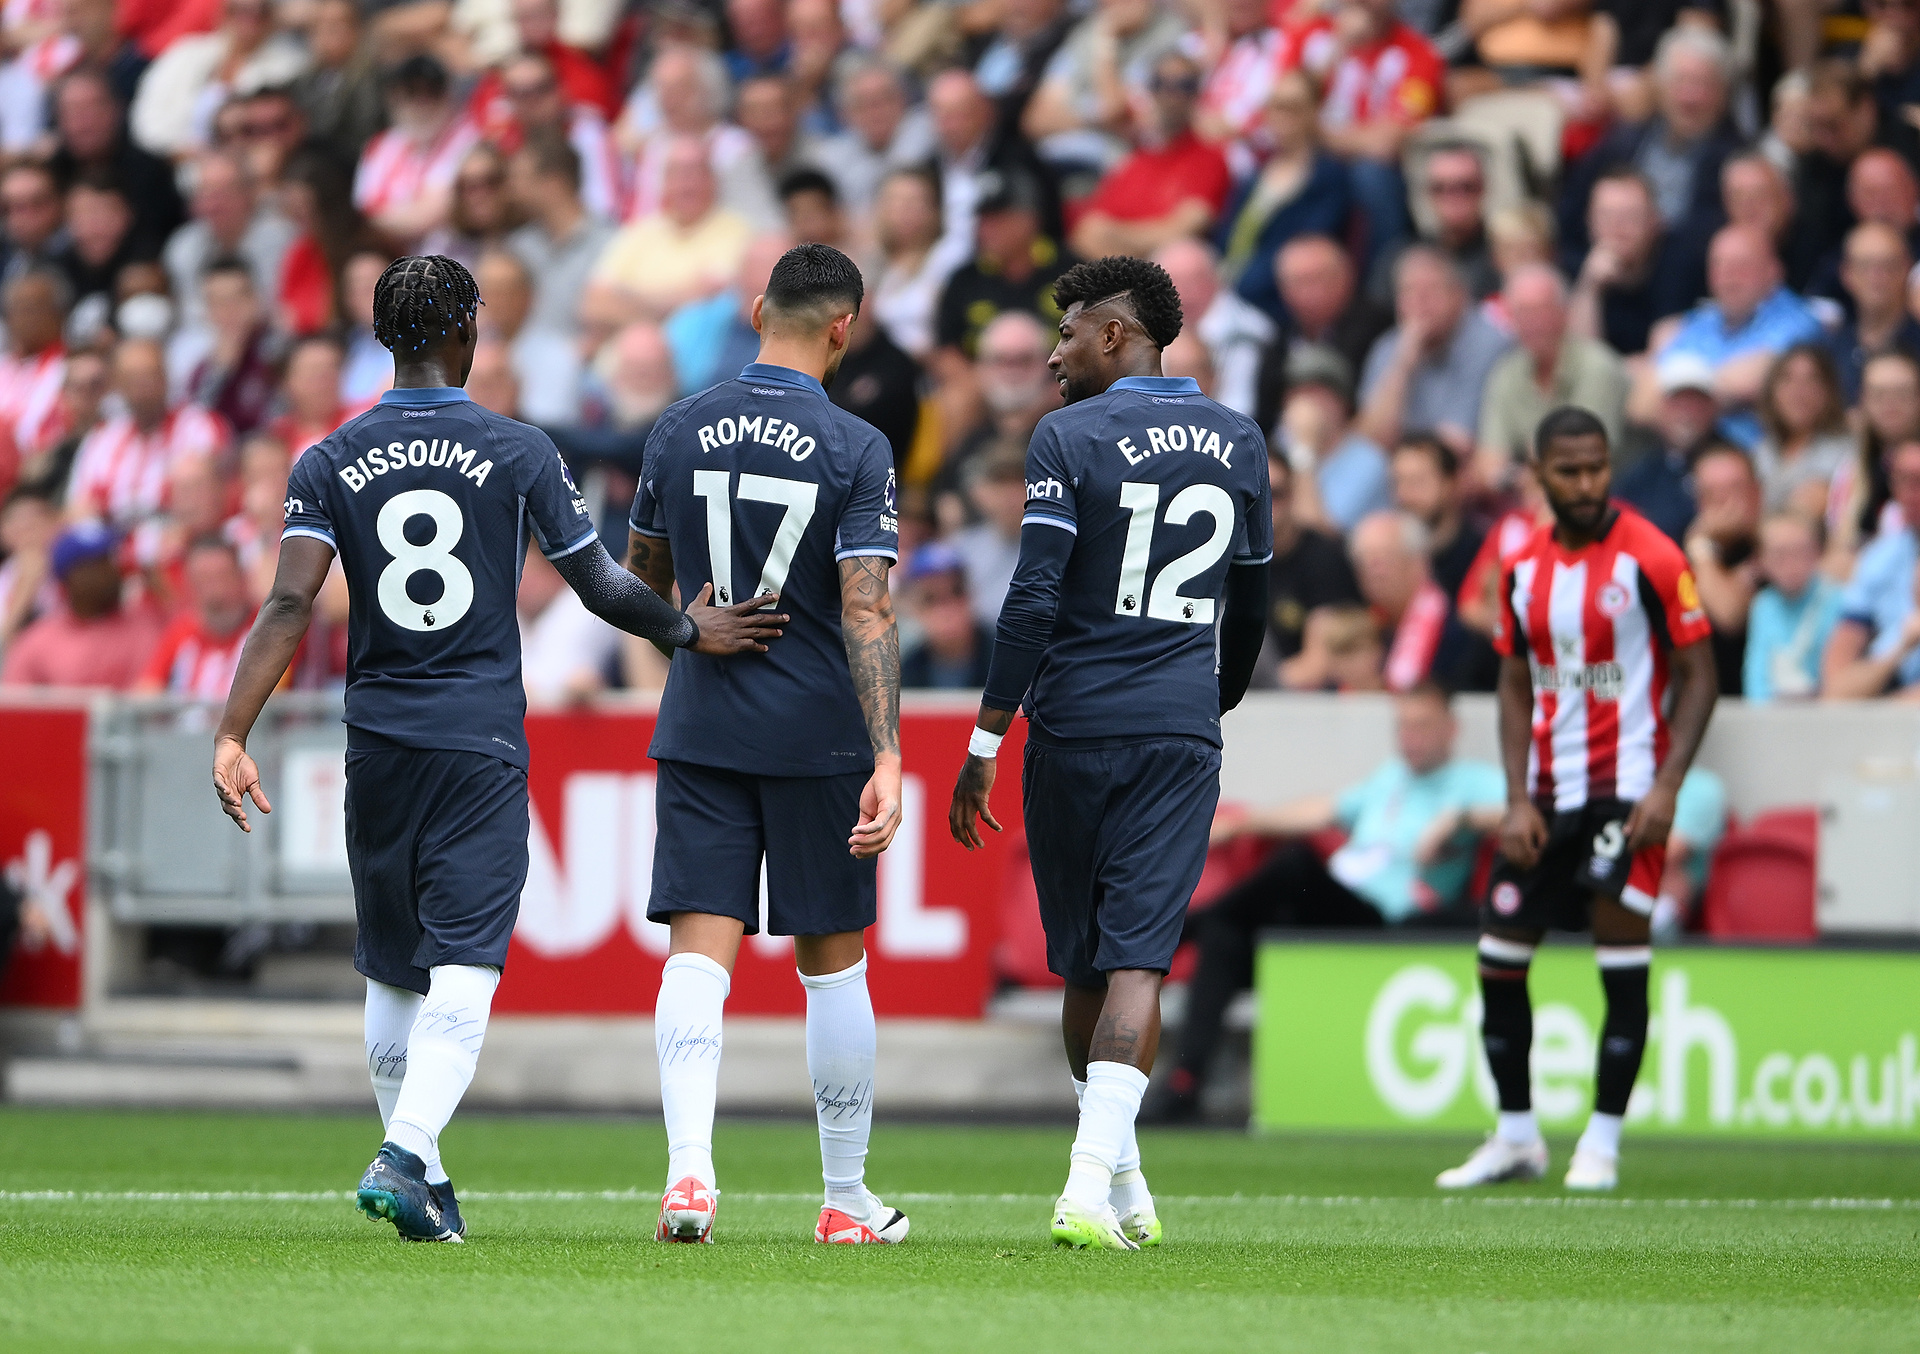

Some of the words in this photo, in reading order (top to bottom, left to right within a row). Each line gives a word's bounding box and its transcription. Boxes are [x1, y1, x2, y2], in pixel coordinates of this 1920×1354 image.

[339, 439, 494, 493] BISSOUMA
[698, 415, 816, 461] ROMERO
[1117, 425, 1234, 470] E.ROYAL
[1025, 477, 1063, 500] nch
[376, 489, 474, 631] 8
[693, 469, 819, 609] 17
[1115, 481, 1235, 624] 12
[1365, 965, 1920, 1123] Geh.co.uk
